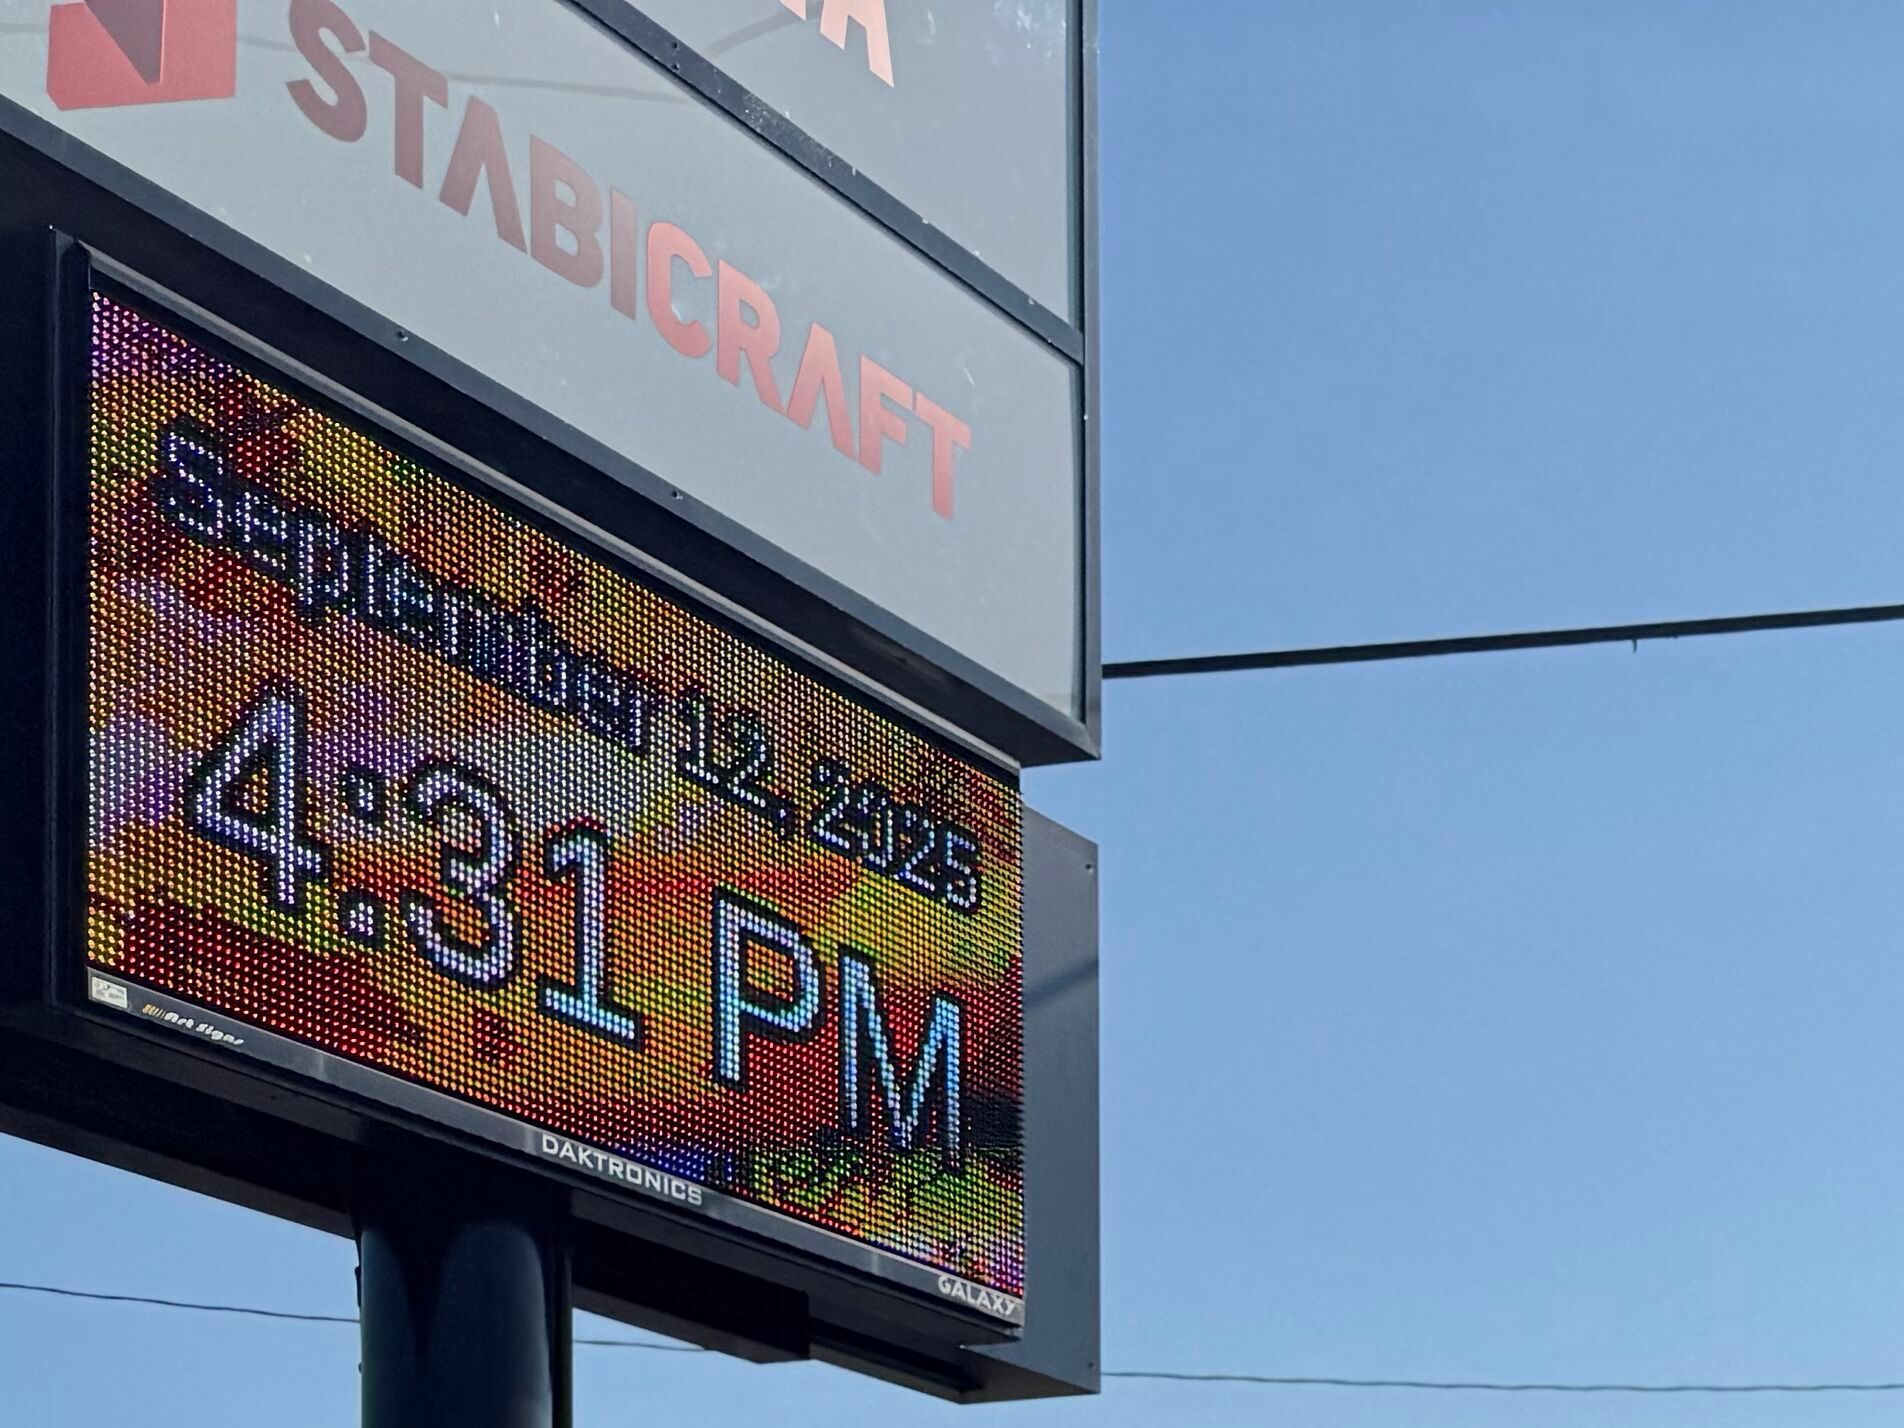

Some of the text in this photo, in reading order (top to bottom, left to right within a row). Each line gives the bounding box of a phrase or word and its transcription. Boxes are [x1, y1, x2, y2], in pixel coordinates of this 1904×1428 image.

[287, 0, 973, 522] STABICRAFT
[160, 422, 645, 750] September
[811, 760, 984, 910] 2025
[197, 690, 965, 1158] 4:31 PM
[541, 1133, 703, 1207] DAKTRONICS
[937, 1273, 1017, 1317] GALAXY
